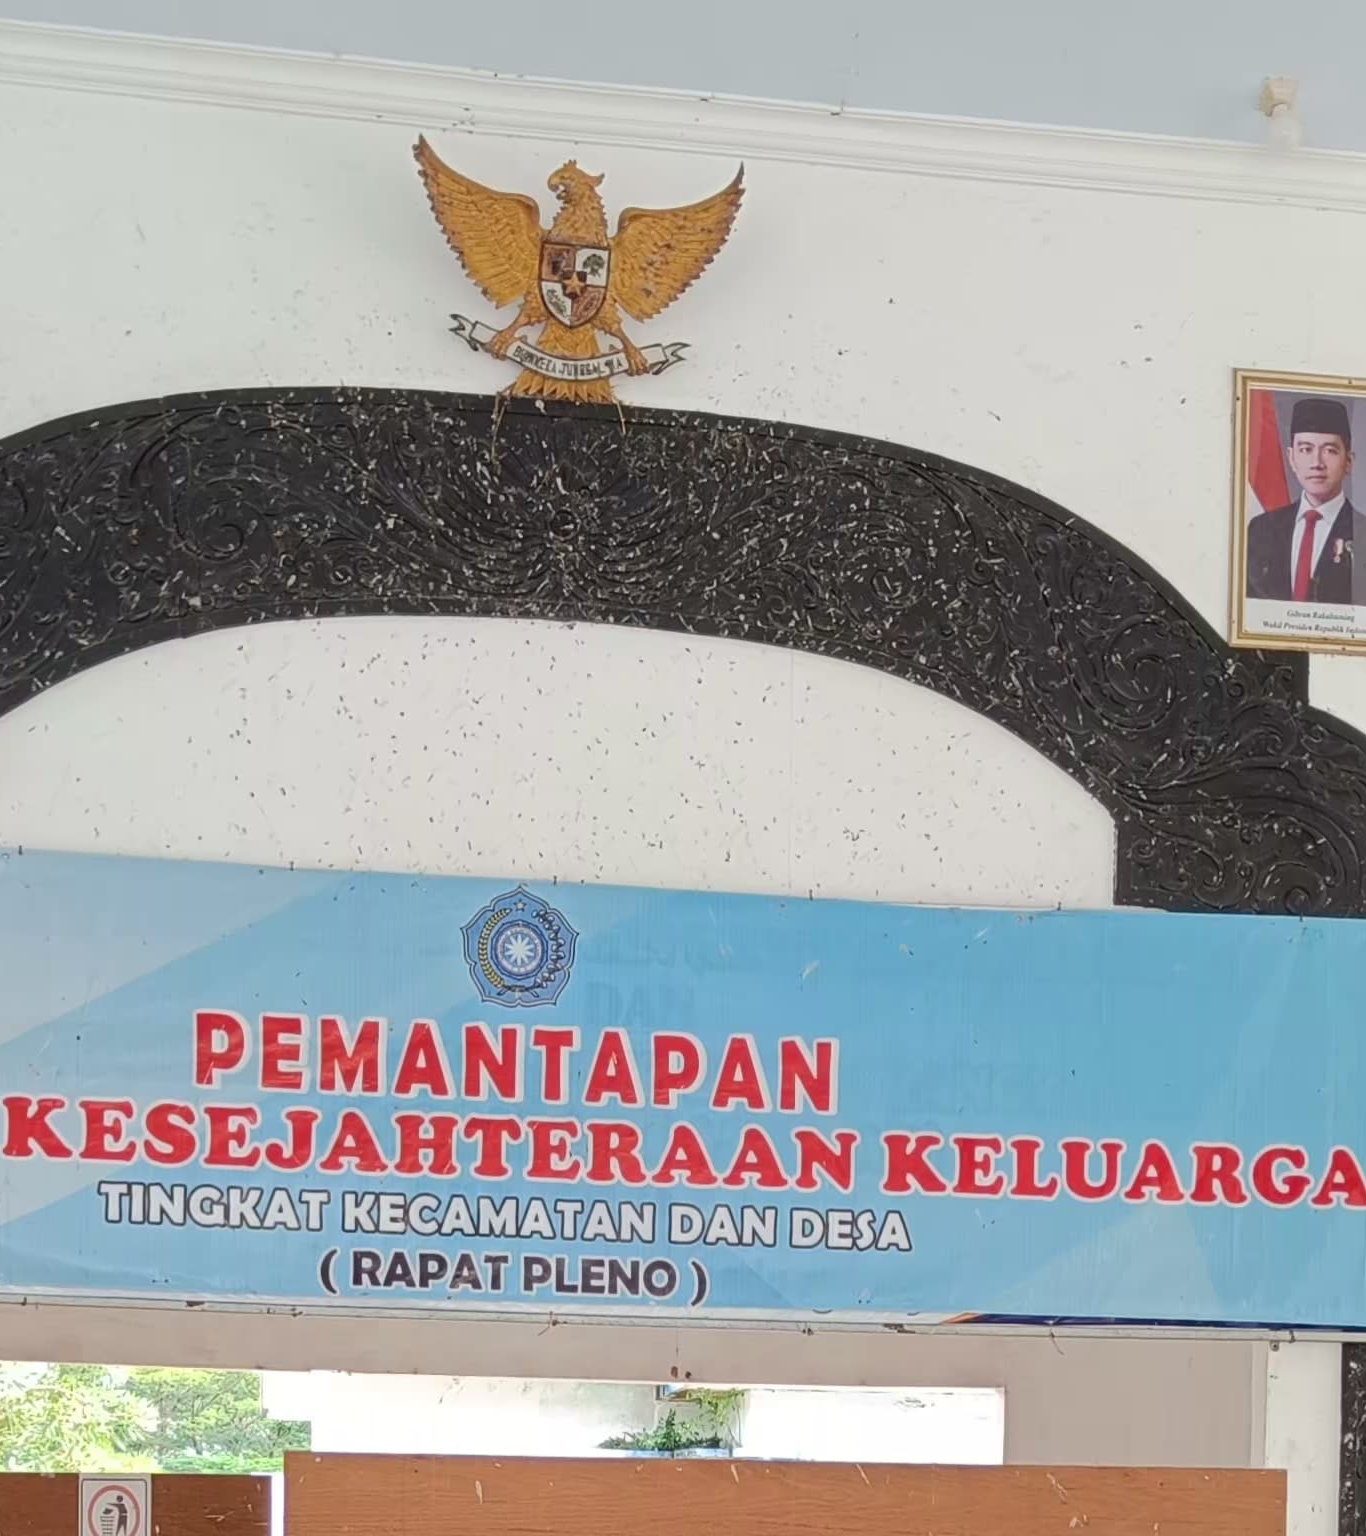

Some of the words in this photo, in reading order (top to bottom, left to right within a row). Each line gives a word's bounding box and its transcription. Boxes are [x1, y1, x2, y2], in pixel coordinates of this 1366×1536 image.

[196, 1013, 832, 1111] PEMANTAPAN
[3, 1097, 857, 1189] KESEJAHTERAAN
[98, 1181, 331, 1231] TINGKAT
[342, 1192, 656, 1243] KECAMATAN
[669, 1203, 777, 1247] DAN
[790, 1208, 912, 1251] DESA
